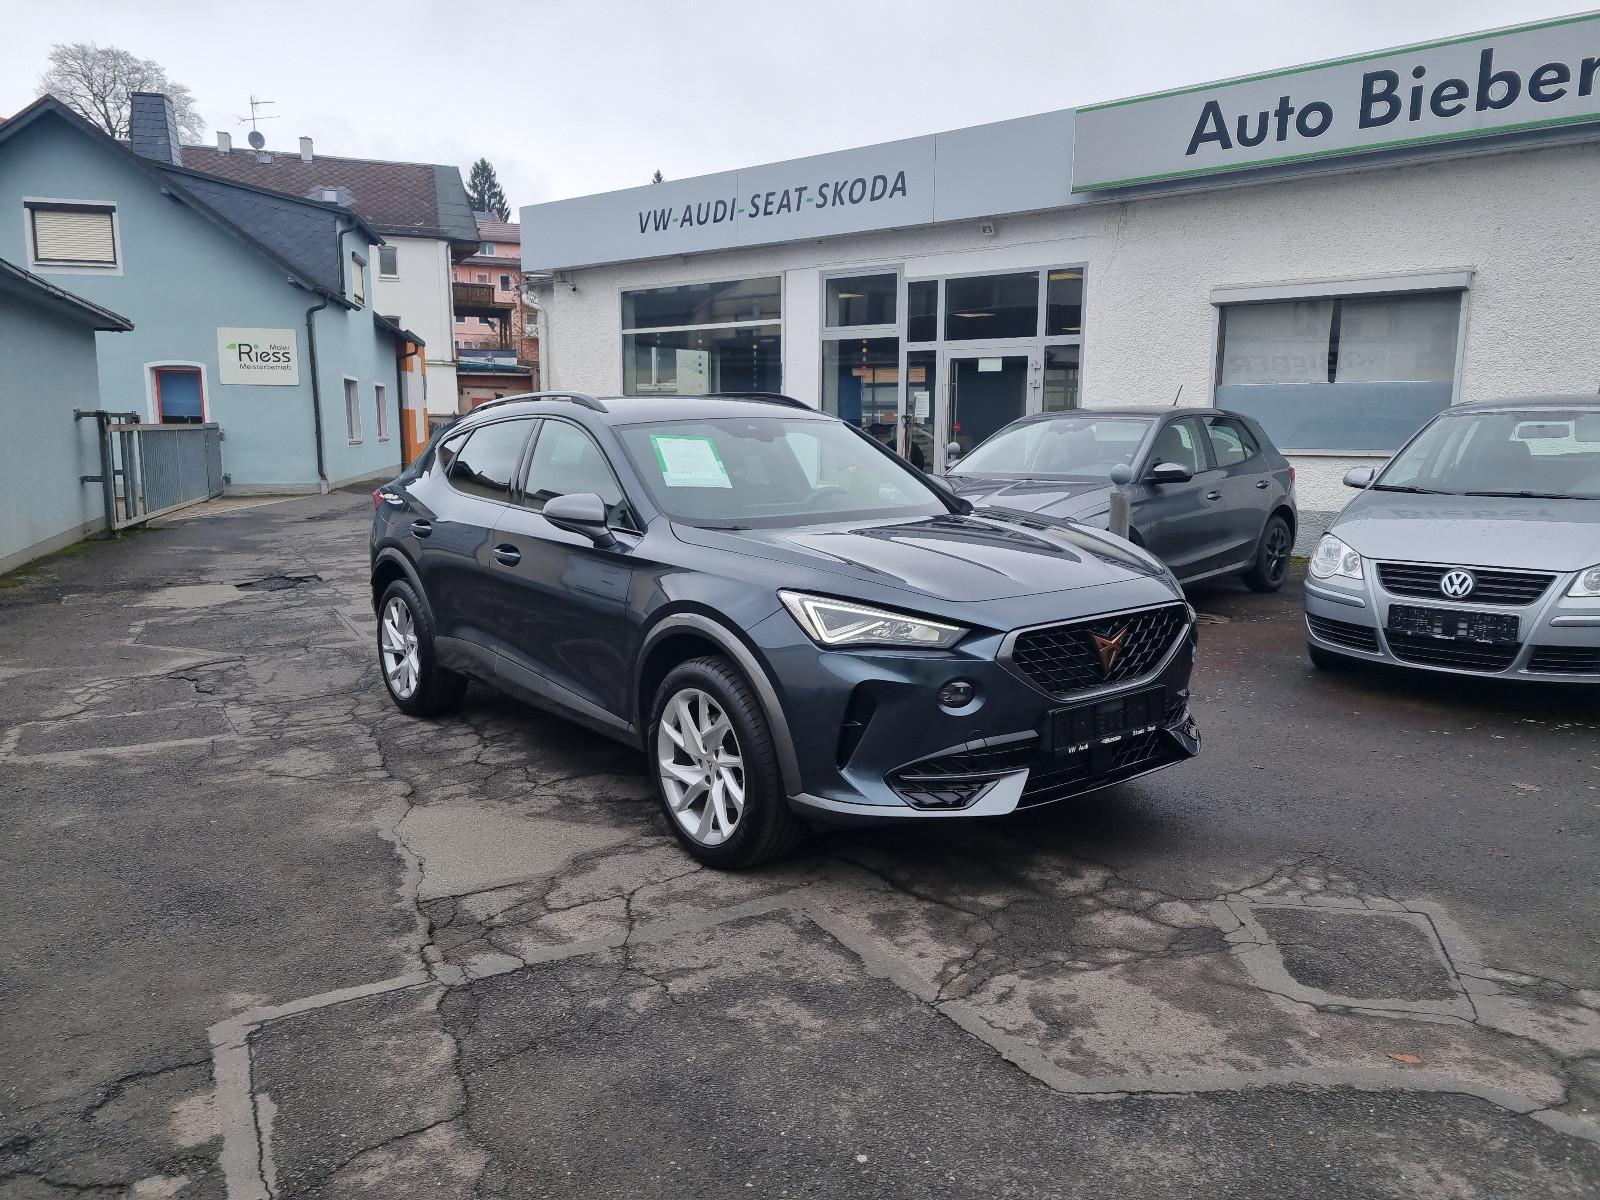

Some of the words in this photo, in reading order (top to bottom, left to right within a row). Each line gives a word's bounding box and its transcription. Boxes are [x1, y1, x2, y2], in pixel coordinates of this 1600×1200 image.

[1184, 95, 1335, 157] Auto
[1357, 46, 1600, 131] Bieber
[238, 343, 292, 363] Riess
[239, 363, 292, 371] Meisterbetrieb
